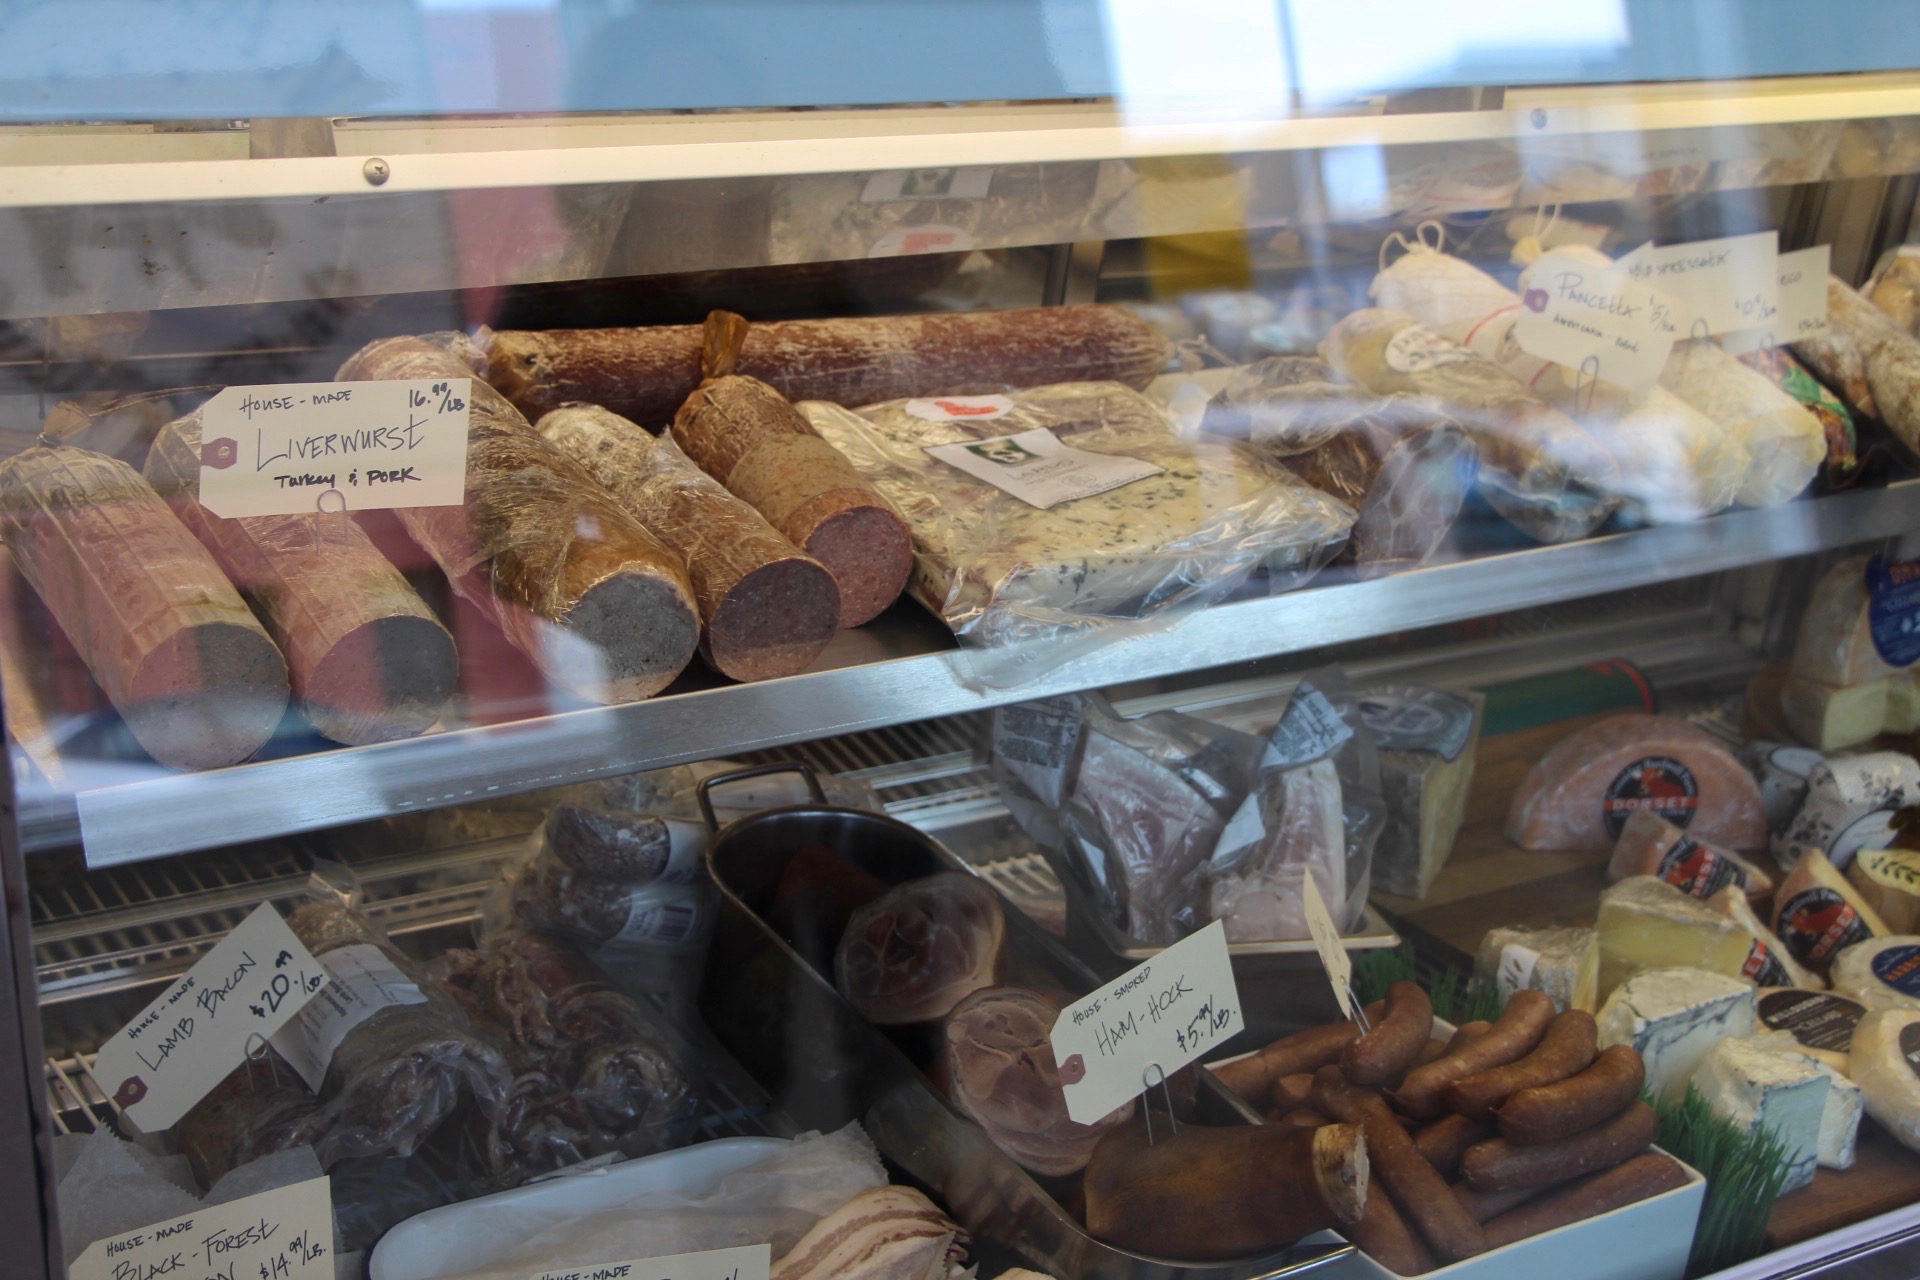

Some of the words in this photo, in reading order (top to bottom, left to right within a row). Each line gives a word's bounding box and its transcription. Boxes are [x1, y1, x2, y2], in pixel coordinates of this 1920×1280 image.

[366, 466, 422, 487] PORK
[135, 1016, 195, 1072] LAMB
[196, 950, 257, 1019] BACON
